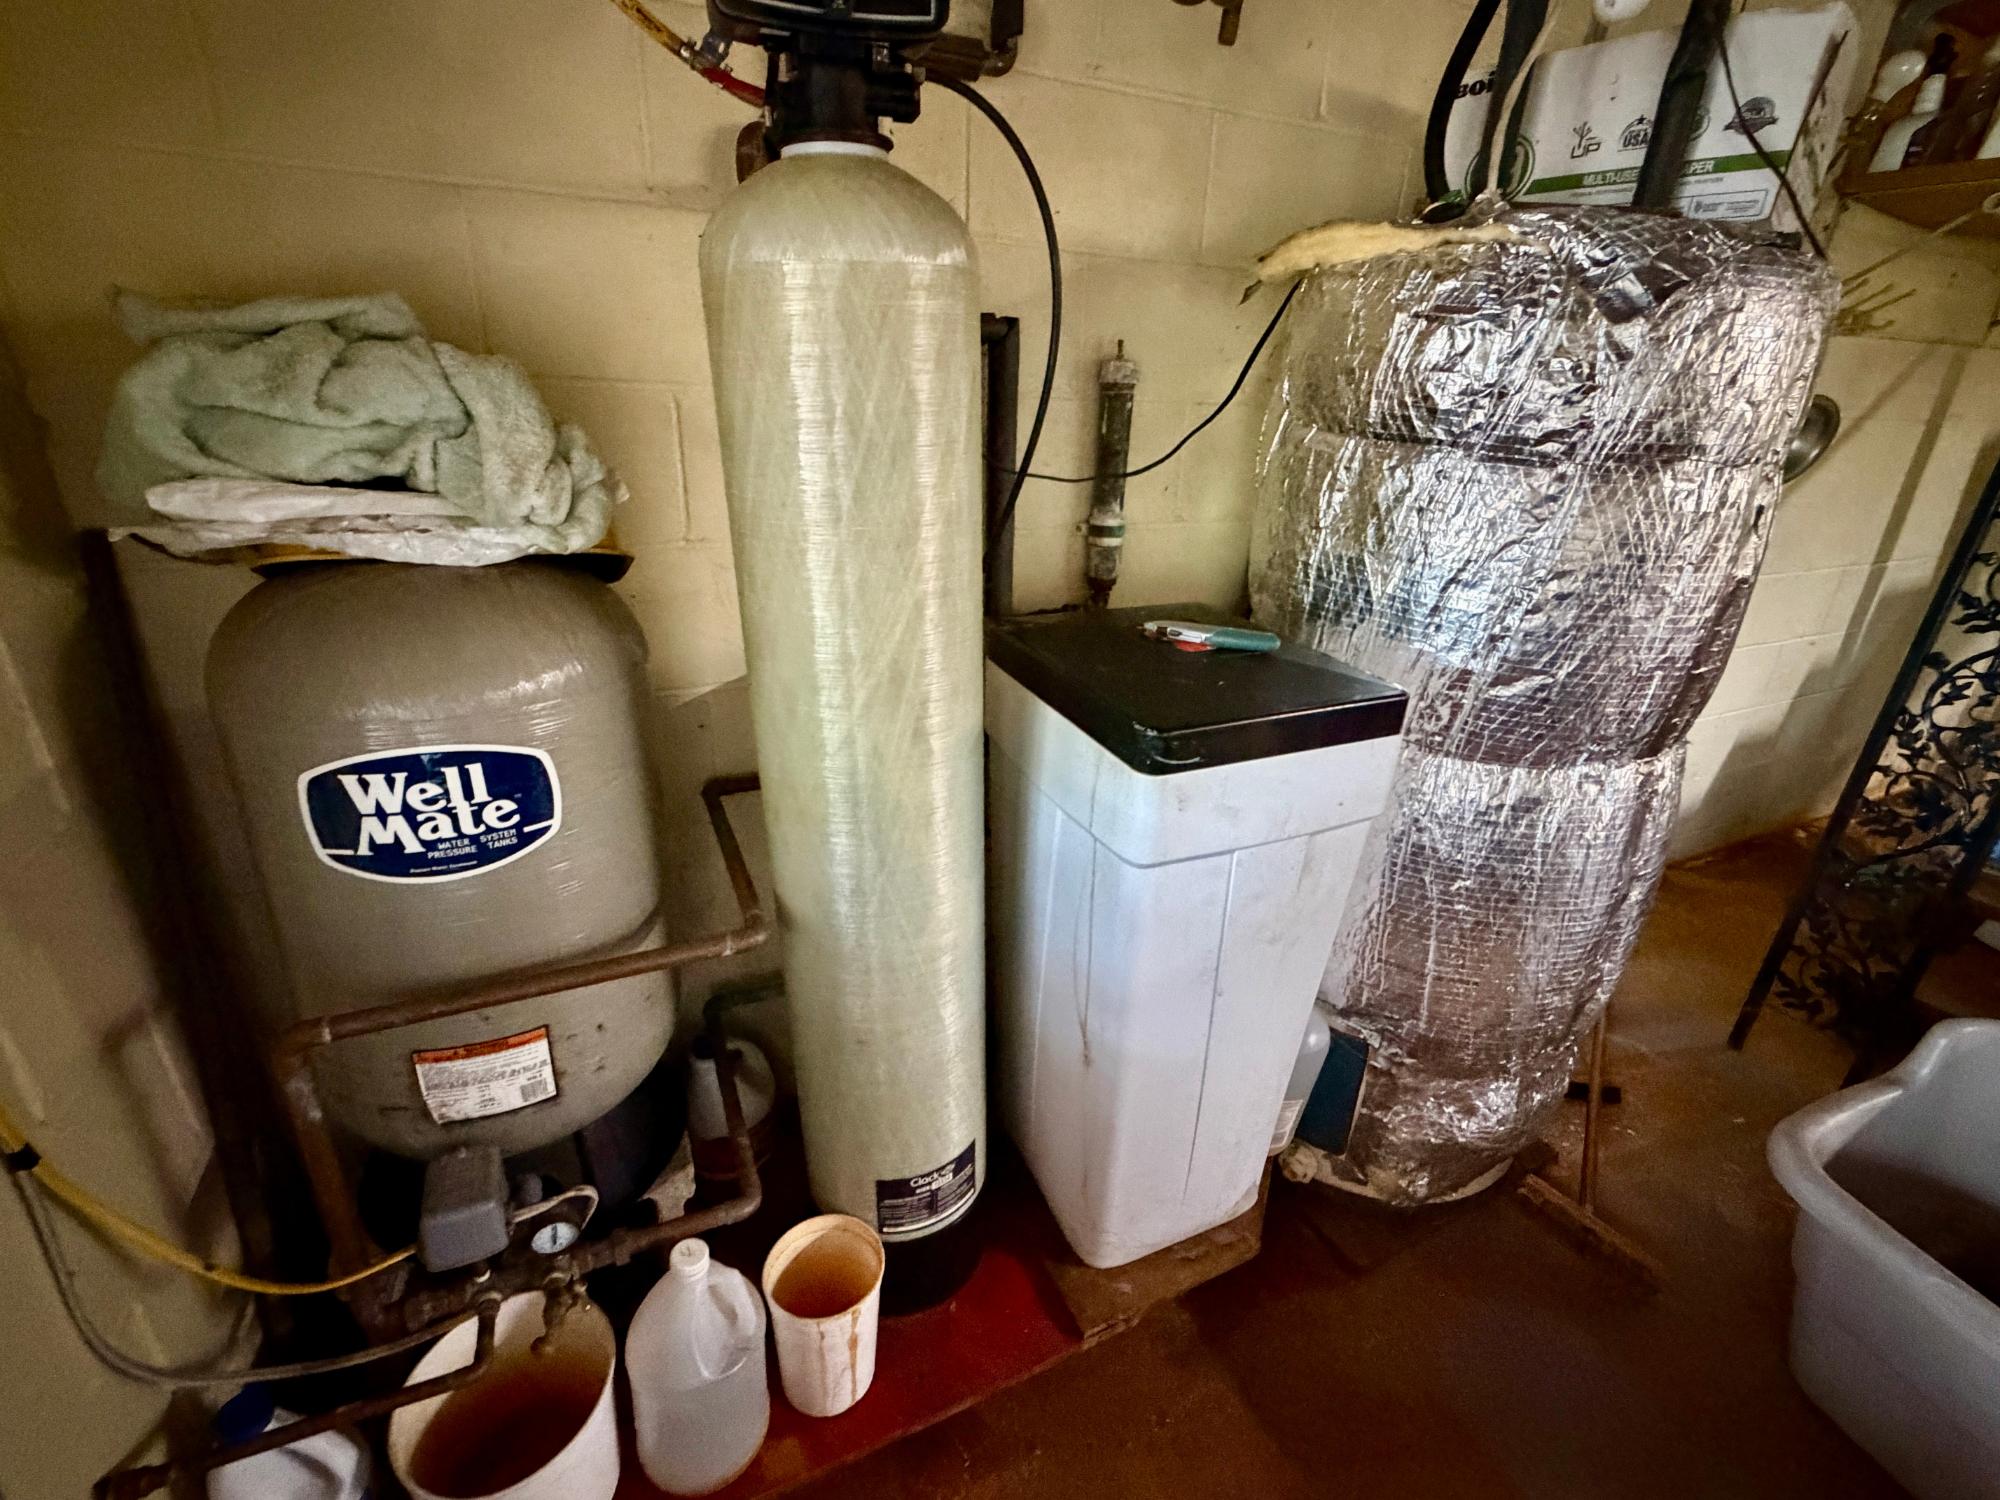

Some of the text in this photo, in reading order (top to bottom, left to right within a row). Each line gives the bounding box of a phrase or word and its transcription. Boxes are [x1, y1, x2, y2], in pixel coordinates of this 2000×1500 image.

[337, 762, 493, 814] Well
[355, 799, 521, 856] Mate
[437, 828, 517, 850] WATER SYSTEM
[427, 836, 518, 859] PRESSURE TANKS
